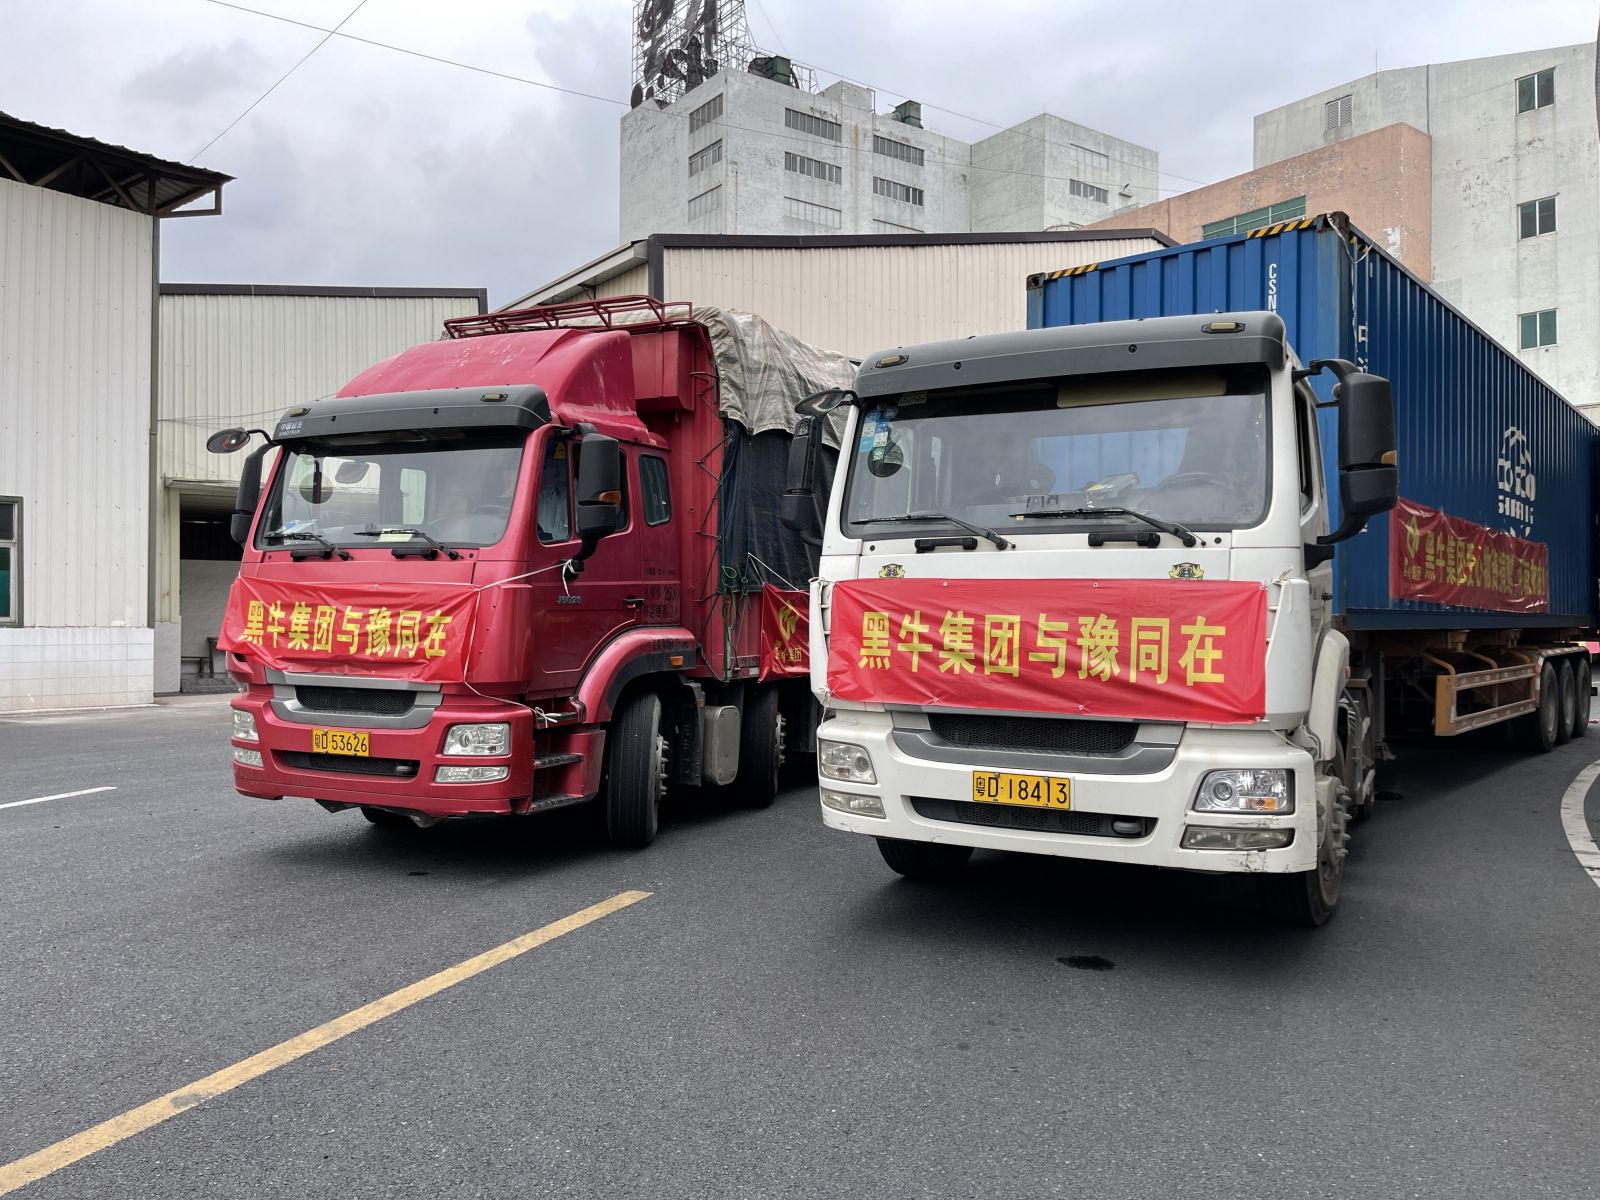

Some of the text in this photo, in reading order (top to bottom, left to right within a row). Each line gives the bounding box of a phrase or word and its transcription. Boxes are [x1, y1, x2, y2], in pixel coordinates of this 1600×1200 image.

[1267, 263, 1277, 314] CSN
[239, 600, 453, 658] 黑牛集团与豫同在
[858, 609, 1227, 686] 黑牛集团与豫同在
